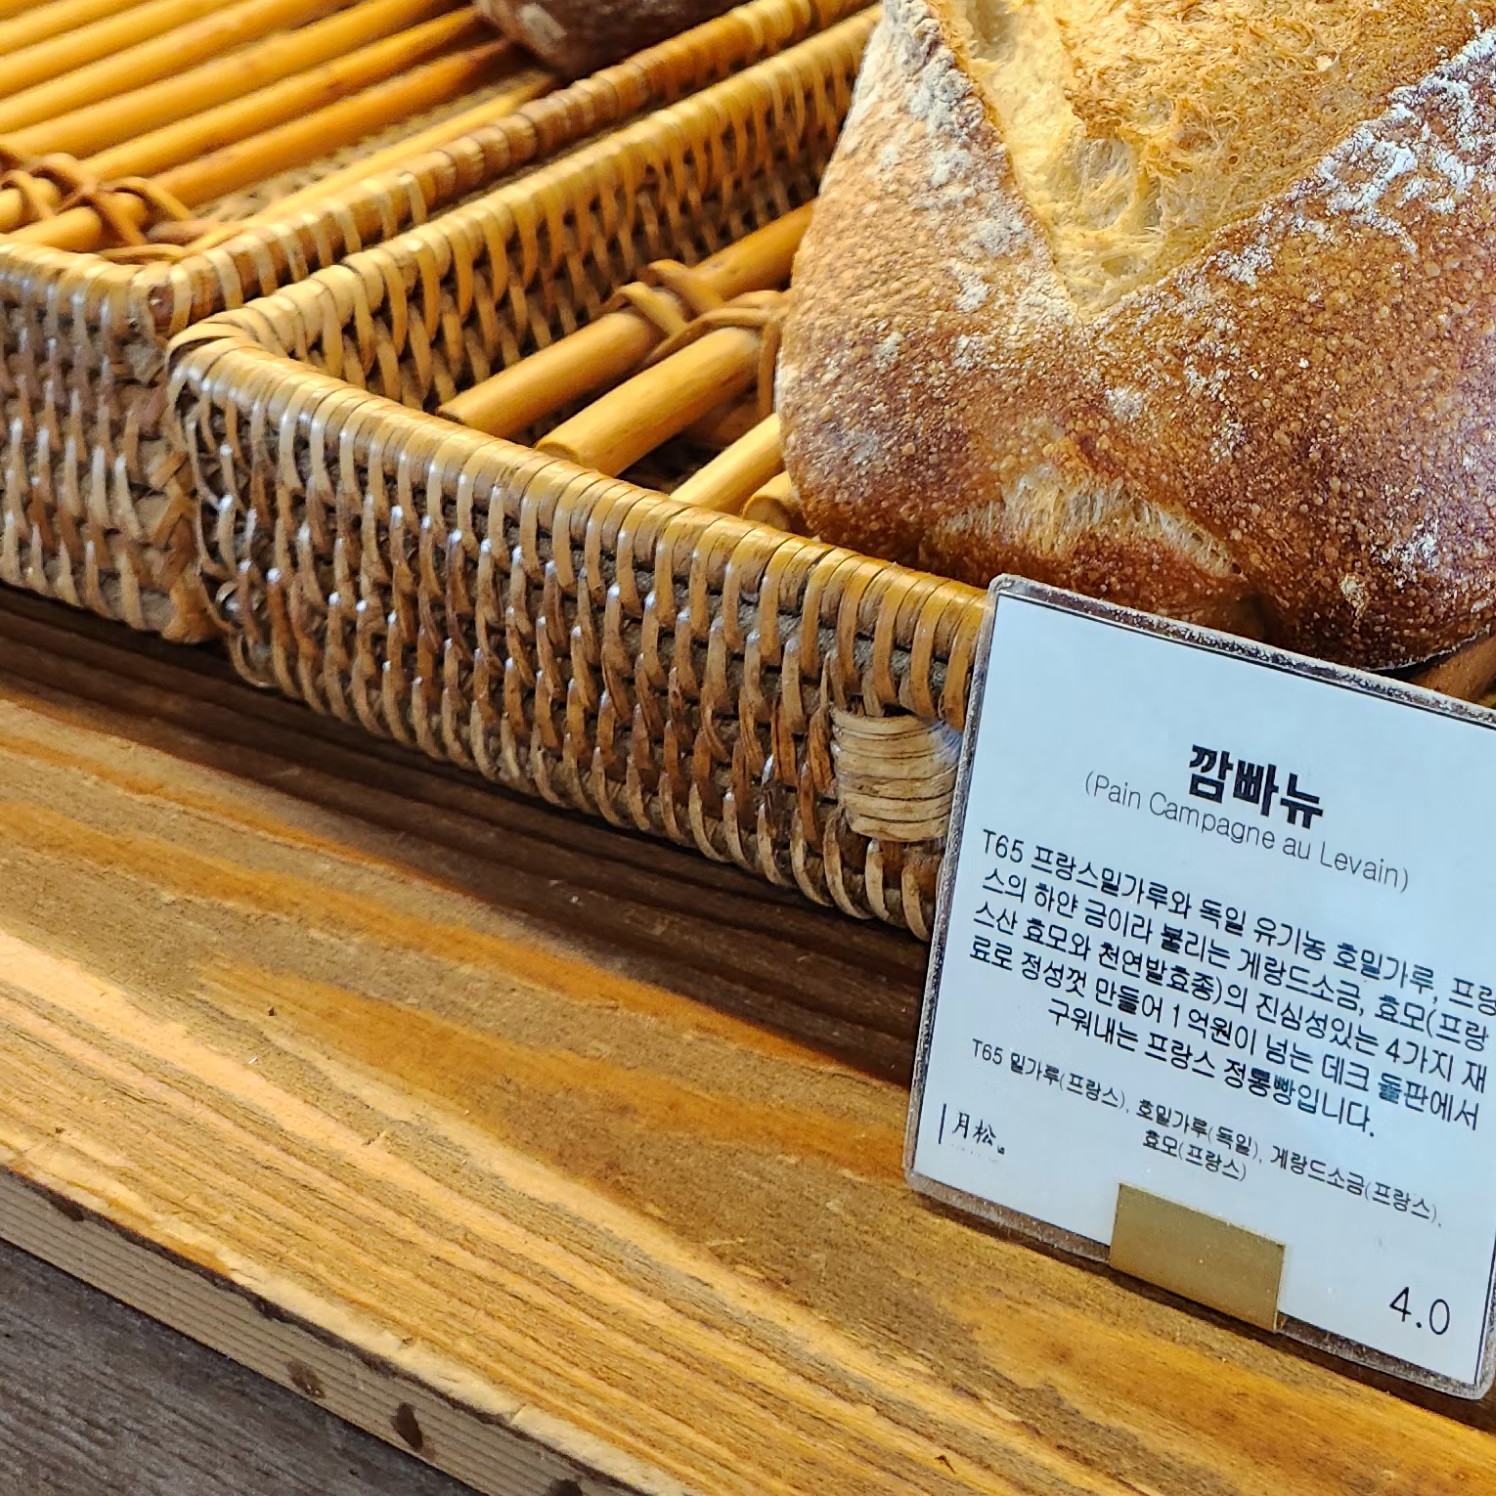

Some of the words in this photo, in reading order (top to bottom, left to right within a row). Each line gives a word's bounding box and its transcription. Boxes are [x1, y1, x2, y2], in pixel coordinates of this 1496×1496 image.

[1085, 770, 1141, 810] (Pain
[1149, 791, 1276, 850] Campagne
[1282, 837, 1312, 861] au
[1319, 840, 1409, 894] Levain)
[1188, 743, 1325, 831] 깜빠뉴
[981, 867, 1028, 904] 스의
[1034, 882, 1079, 920] 하얀
[1084, 898, 1154, 945] 금이라
[1159, 922, 1231, 970] 불리는
[1236, 947, 1365, 1017] 게랑드소금,
[1373, 993, 1490, 1053] 효모(프랑
[982, 828, 1025, 864] T65
[1030, 844, 1193, 920] 프랑스밀가루와
[1198, 898, 1247, 938] 독일
[1252, 916, 1327, 962] 유기농
[1332, 941, 1438, 1005] 호밀가루,
[969, 934, 1013, 972] 료로
[1020, 951, 1088, 999] 정성껏
[1095, 977, 1164, 1024] 만들어
[1265, 1033, 1314, 1075] 넘는
[1321, 1053, 1370, 1093] 데크
[1377, 1071, 1480, 1132] 돌판에서
[971, 1037, 1004, 1066] T65
[973, 900, 1019, 937] 스산
[1022, 917, 1092, 963] 효모와
[1098, 941, 1249, 1015] 천연발효종)의
[1255, 992, 1380, 1057] 진심성있는
[1384, 1037, 1454, 1083] 4가지
[1460, 1060, 1488, 1094] 재
[1047, 997, 1139, 1053] 구워내는
[1144, 1031, 1216, 1079] 프랑스
[1223, 1057, 1375, 1138] 정통빵입니다.
[1388, 1286, 1451, 1336] 4.0
